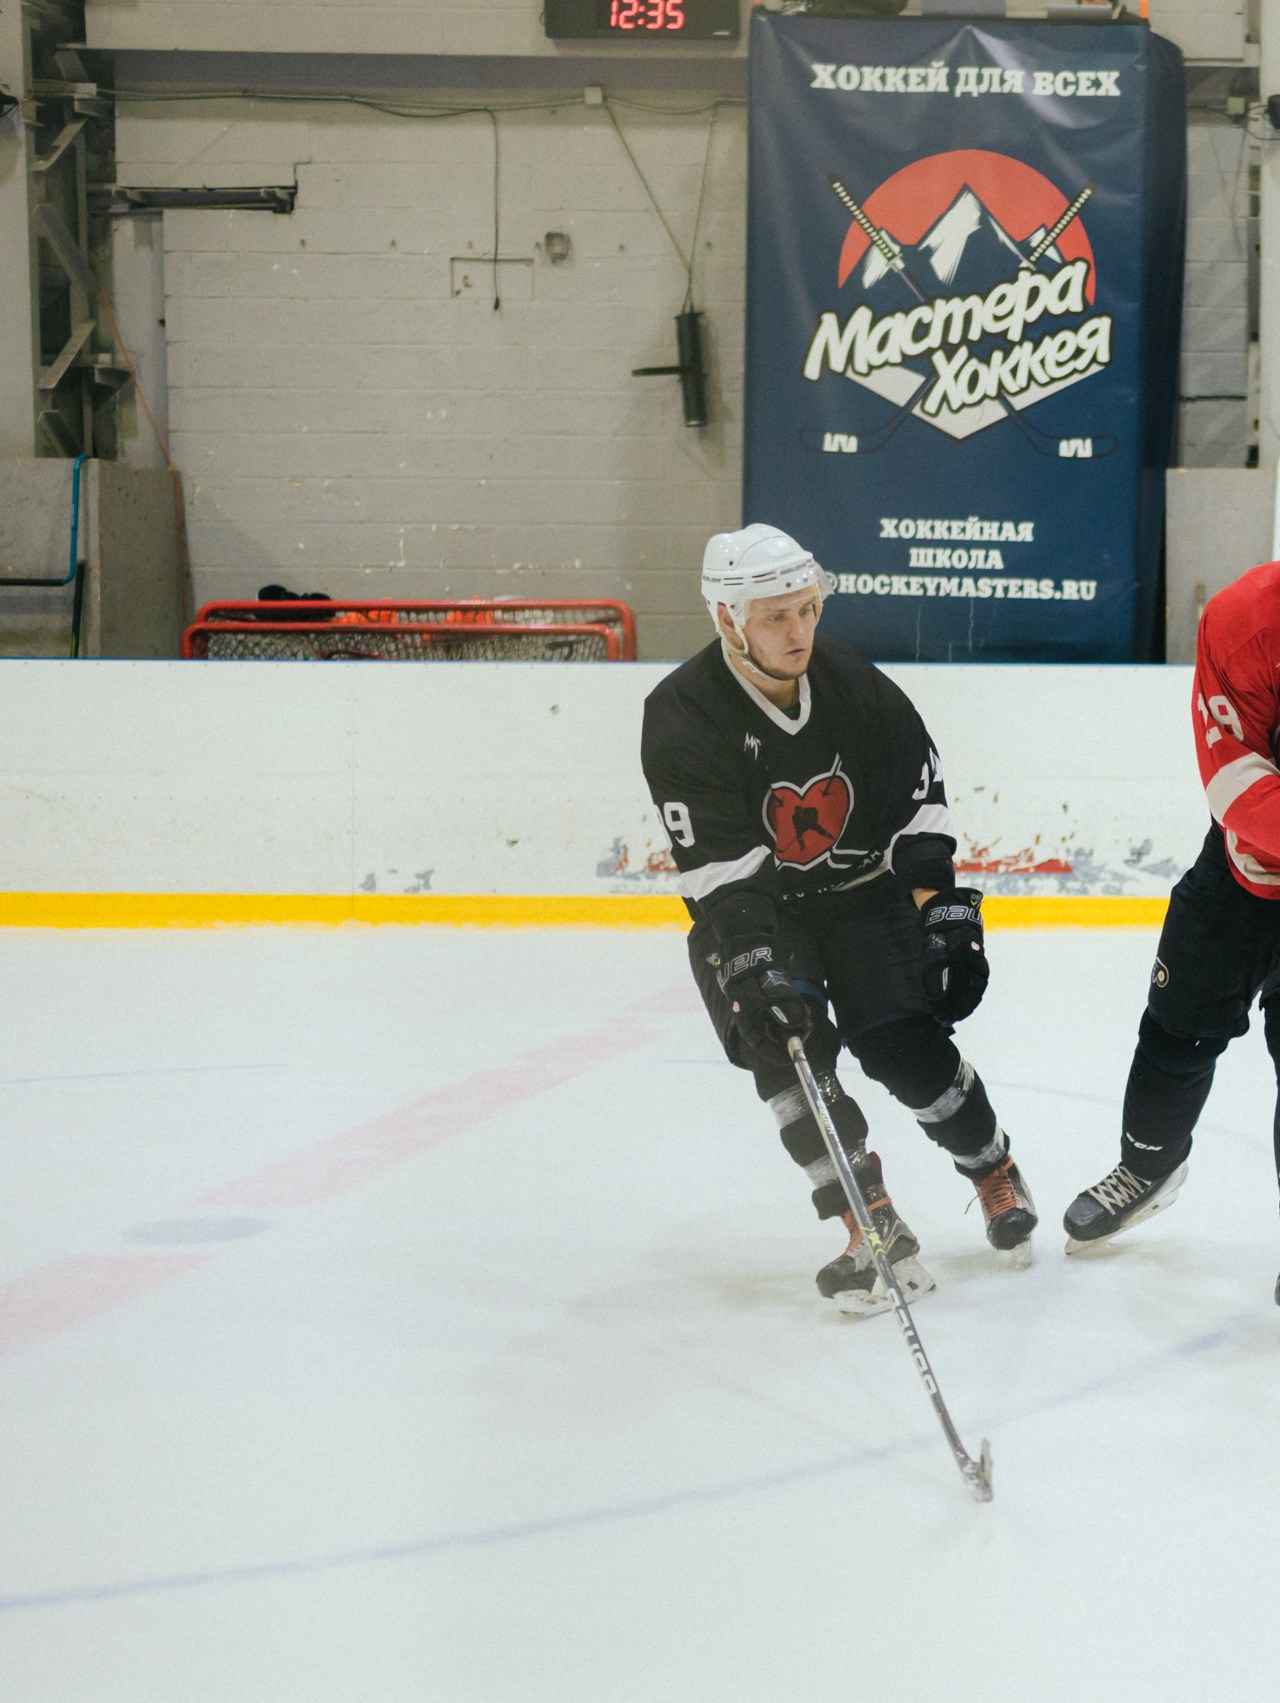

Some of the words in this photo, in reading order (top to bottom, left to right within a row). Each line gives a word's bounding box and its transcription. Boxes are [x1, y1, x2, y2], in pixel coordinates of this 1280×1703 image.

[610, 0, 685, 30] 12:35
[810, 60, 949, 93] ХОККЕЙ
[954, 66, 1025, 98] ДЛЯ
[1032, 70, 1121, 97] ВСЕХ
[802, 259, 1089, 382] Мастера
[919, 315, 1113, 416] Хоккея
[880, 516, 1034, 542] ХОККЕЙНАЯ
[909, 547, 1004, 570] ШКОЛА
